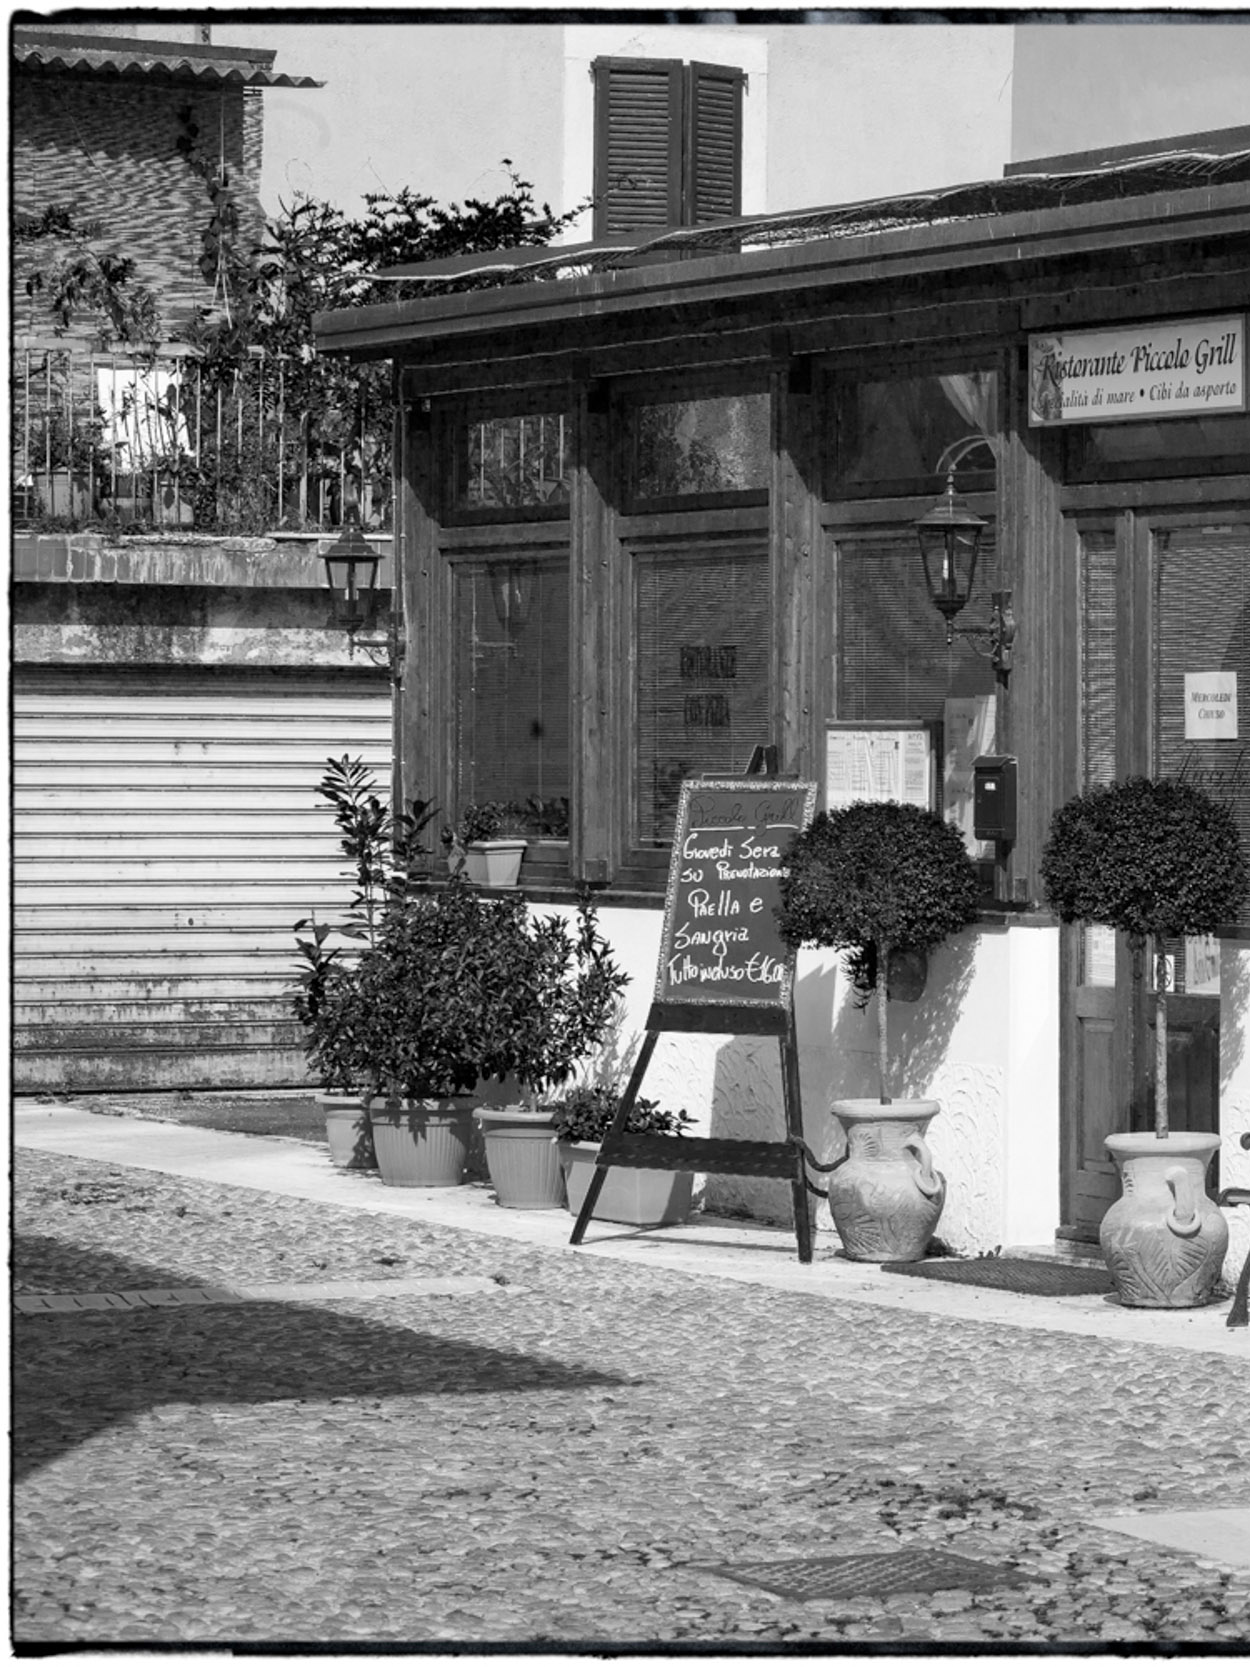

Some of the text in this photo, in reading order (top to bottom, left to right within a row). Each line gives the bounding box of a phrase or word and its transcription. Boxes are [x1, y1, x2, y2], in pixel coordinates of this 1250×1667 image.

[1040, 333, 1237, 387] Ristorante Piccolo Grill
[1091, 387, 1104, 406] di
[1106, 391, 1135, 405] mare
[1149, 382, 1172, 401] Cibi
[1175, 381, 1190, 400] da
[1193, 381, 1237, 402] asporto
[738, 836, 781, 860] Sera
